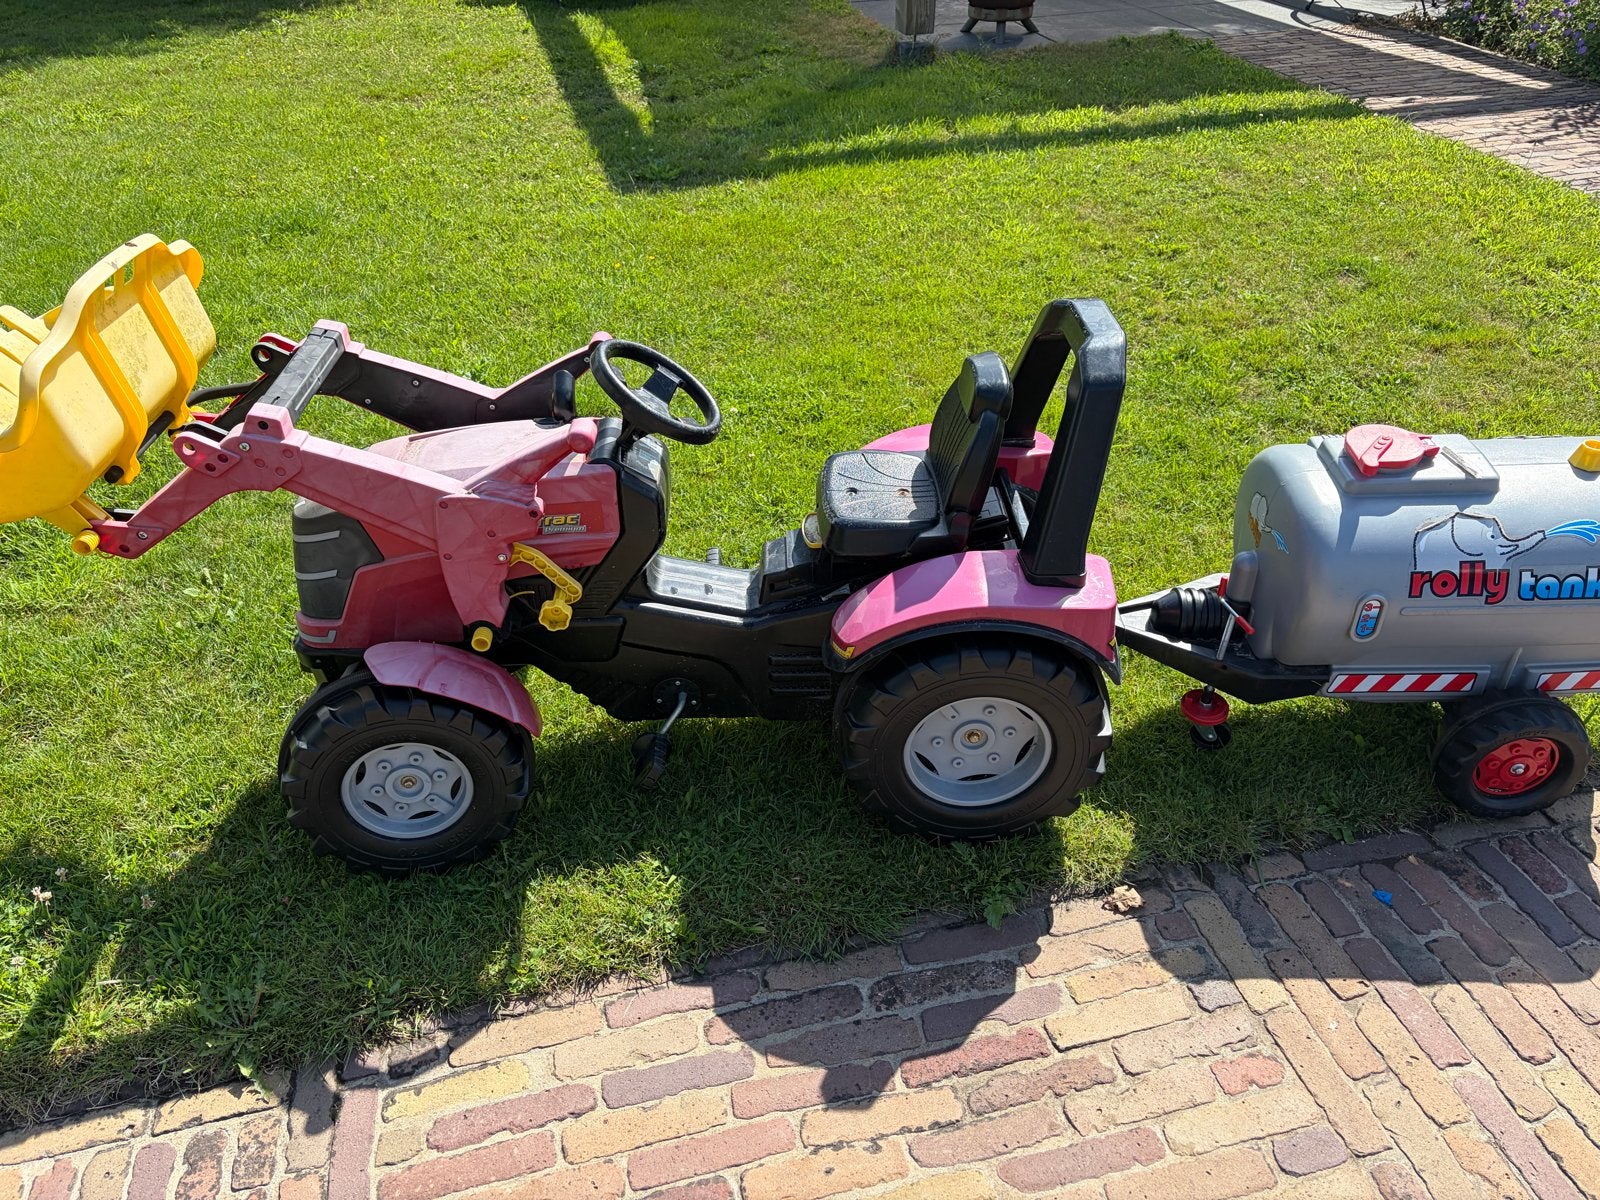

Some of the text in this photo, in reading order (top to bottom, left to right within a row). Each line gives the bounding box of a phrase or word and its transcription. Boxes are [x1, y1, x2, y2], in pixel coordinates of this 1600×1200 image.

[541, 514, 579, 527] rac
[1408, 560, 1510, 605] rolly
[1364, 603, 1373, 612] 3
[1361, 614, 1370, 622] 2
[1360, 624, 1367, 632] 1
